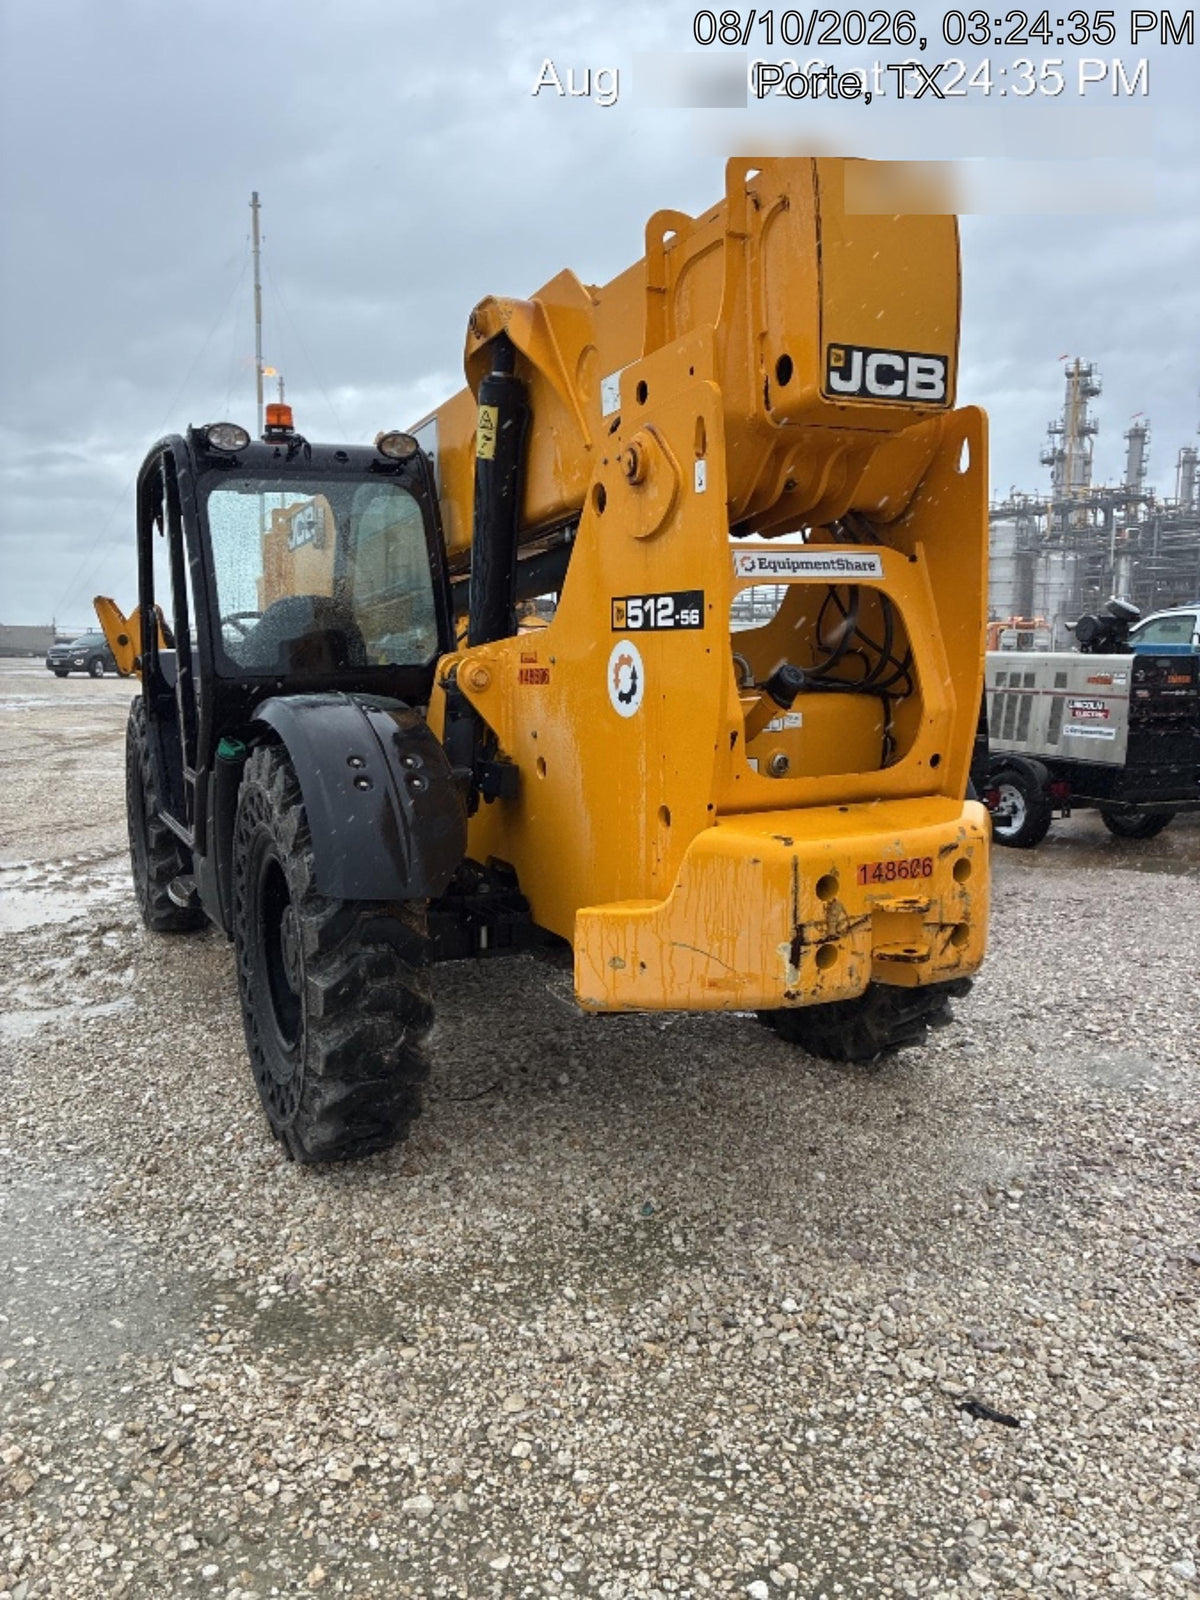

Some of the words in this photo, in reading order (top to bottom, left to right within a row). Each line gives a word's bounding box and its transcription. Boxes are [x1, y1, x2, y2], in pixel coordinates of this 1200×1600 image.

[829, 350, 945, 399] JCB
[757, 557, 876, 573] EquipmentShare
[858, 857, 934, 885] 148606
